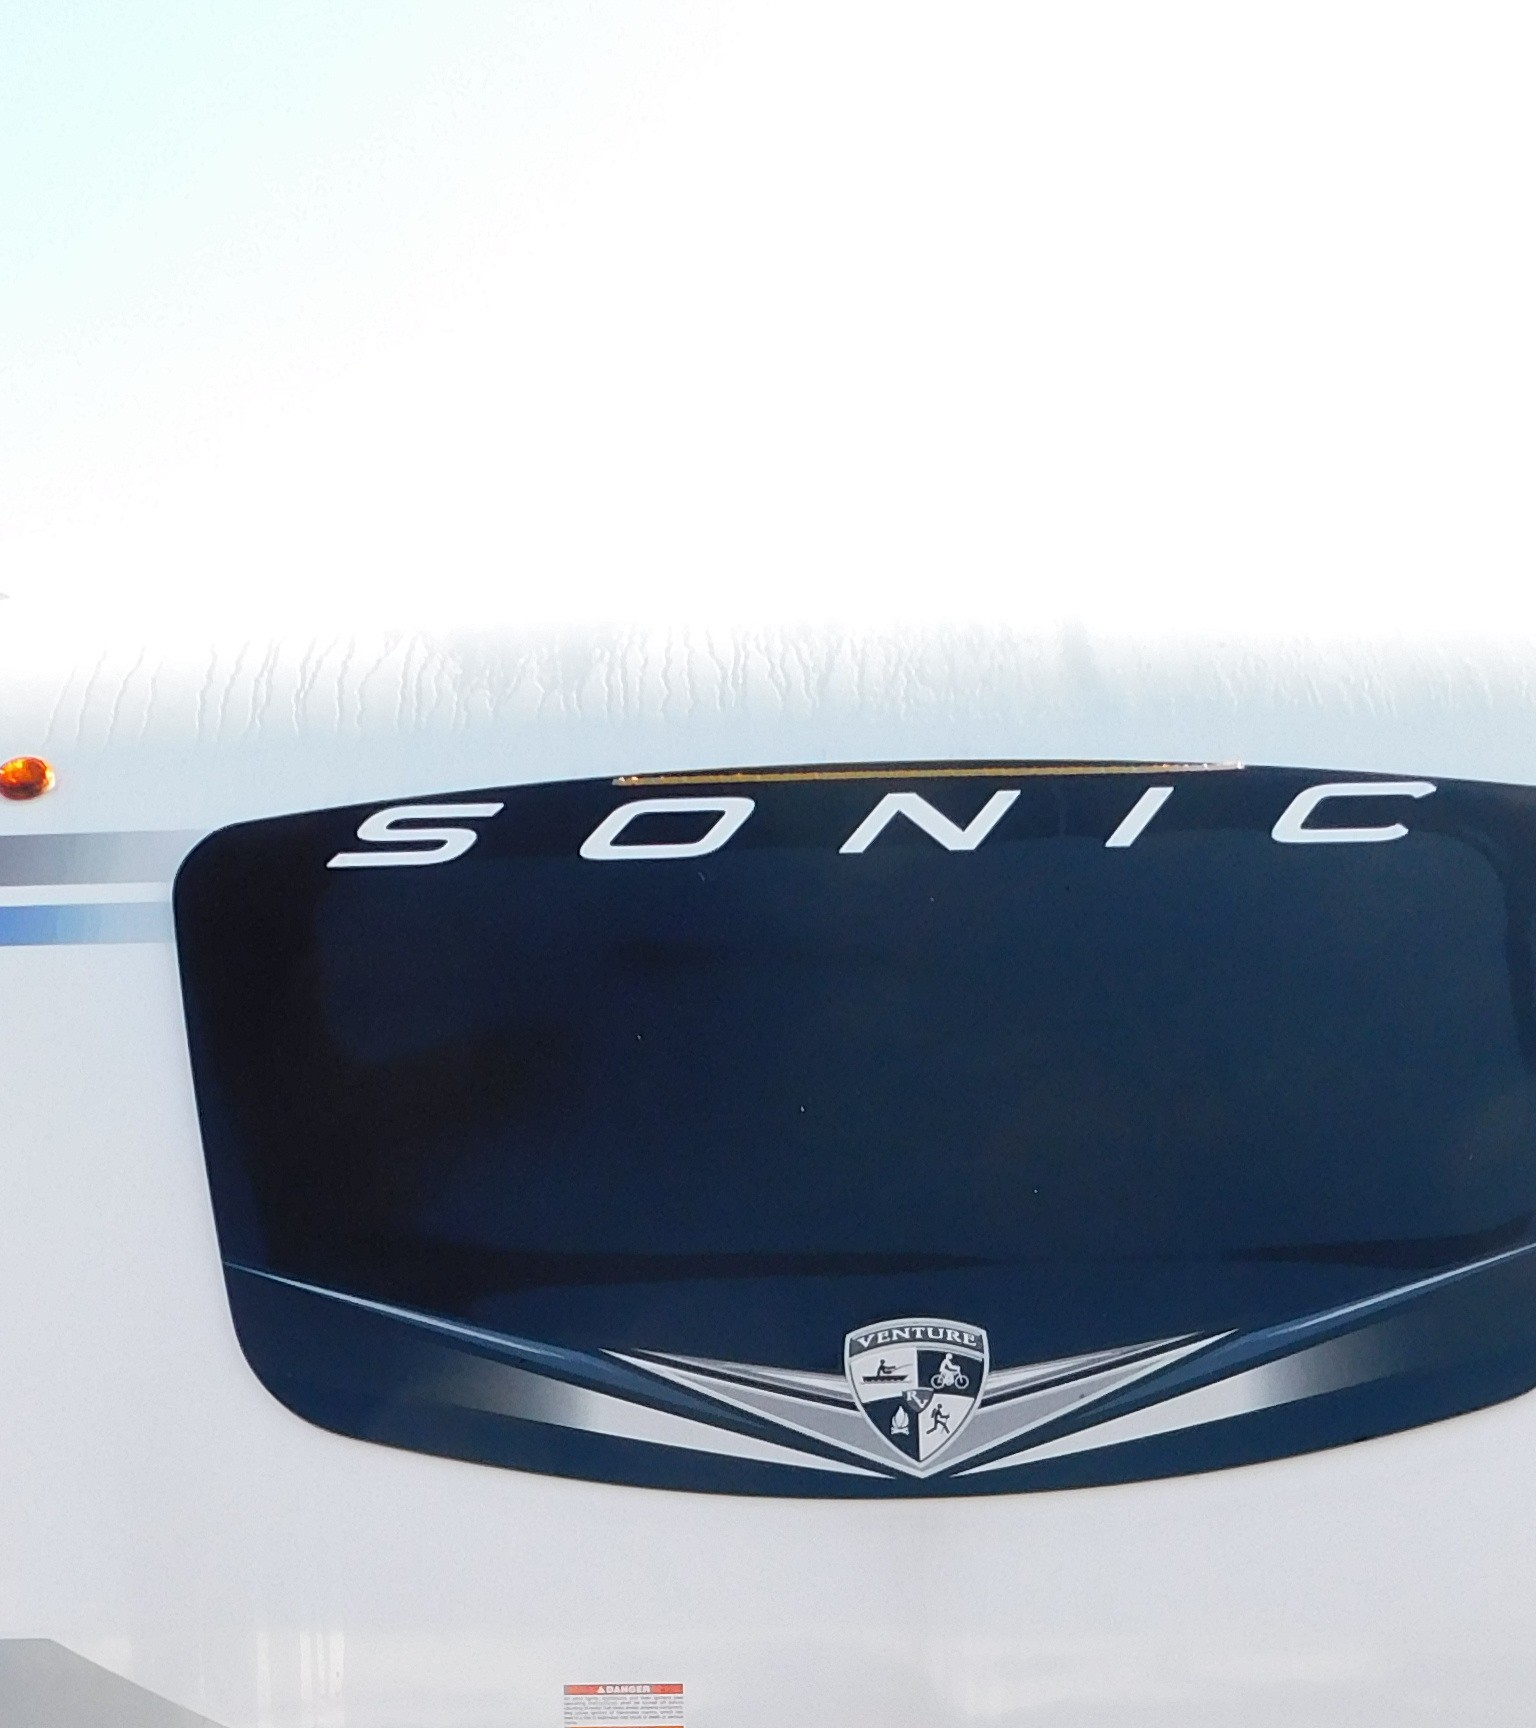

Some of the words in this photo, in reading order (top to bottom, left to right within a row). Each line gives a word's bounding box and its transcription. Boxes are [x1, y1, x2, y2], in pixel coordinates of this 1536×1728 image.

[326, 780, 1439, 871] SONIC
[855, 1326, 978, 1349] VENTURE
[905, 1390, 929, 1409] RV
[606, 1685, 651, 1694] DANGER
